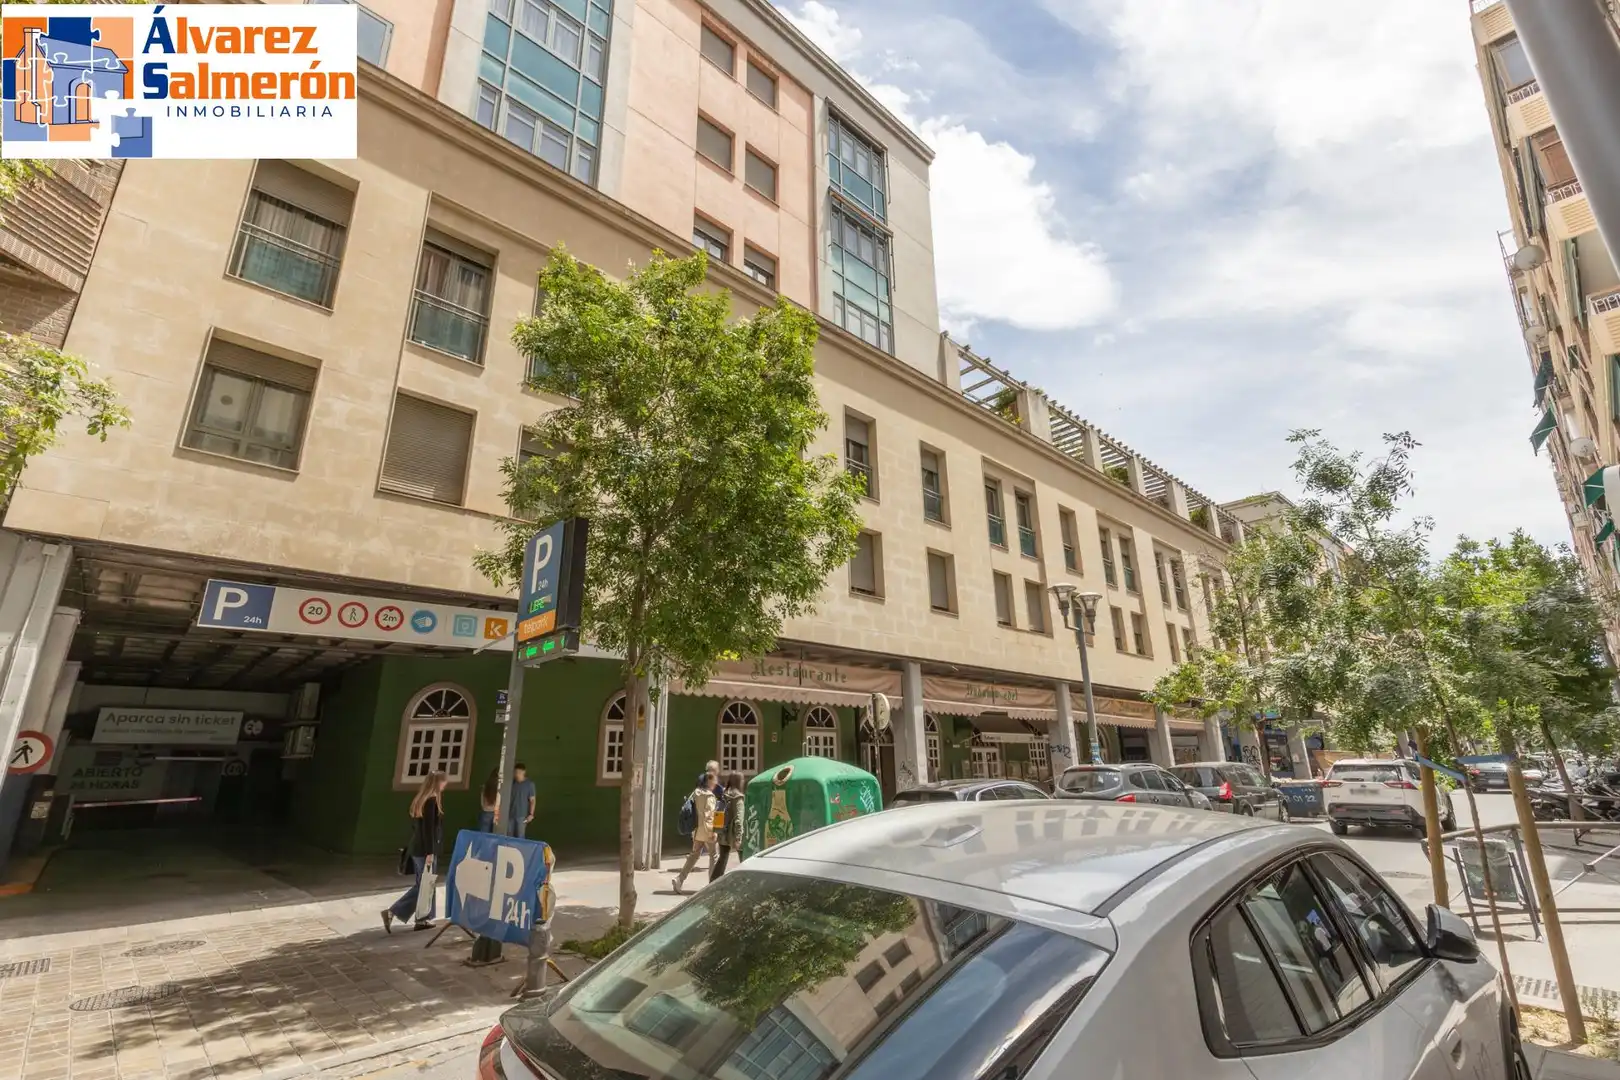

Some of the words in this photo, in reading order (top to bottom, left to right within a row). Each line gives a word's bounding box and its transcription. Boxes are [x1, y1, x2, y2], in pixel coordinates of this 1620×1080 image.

[531, 534, 553, 594] P
[212, 586, 249, 621] P
[308, 606, 324, 616] 20
[382, 613, 397, 623] 2m
[243, 615, 263, 625] 24h
[750, 659, 848, 683] Restaurante
[105, 712, 166, 726] Aparca
[169, 713, 191, 725] sin
[194, 714, 237, 726] ticket
[72, 767, 144, 778] ABIERTO
[89, 779, 140, 789] HORAS
[488, 845, 525, 921] P
[504, 897, 531, 931] 24h
